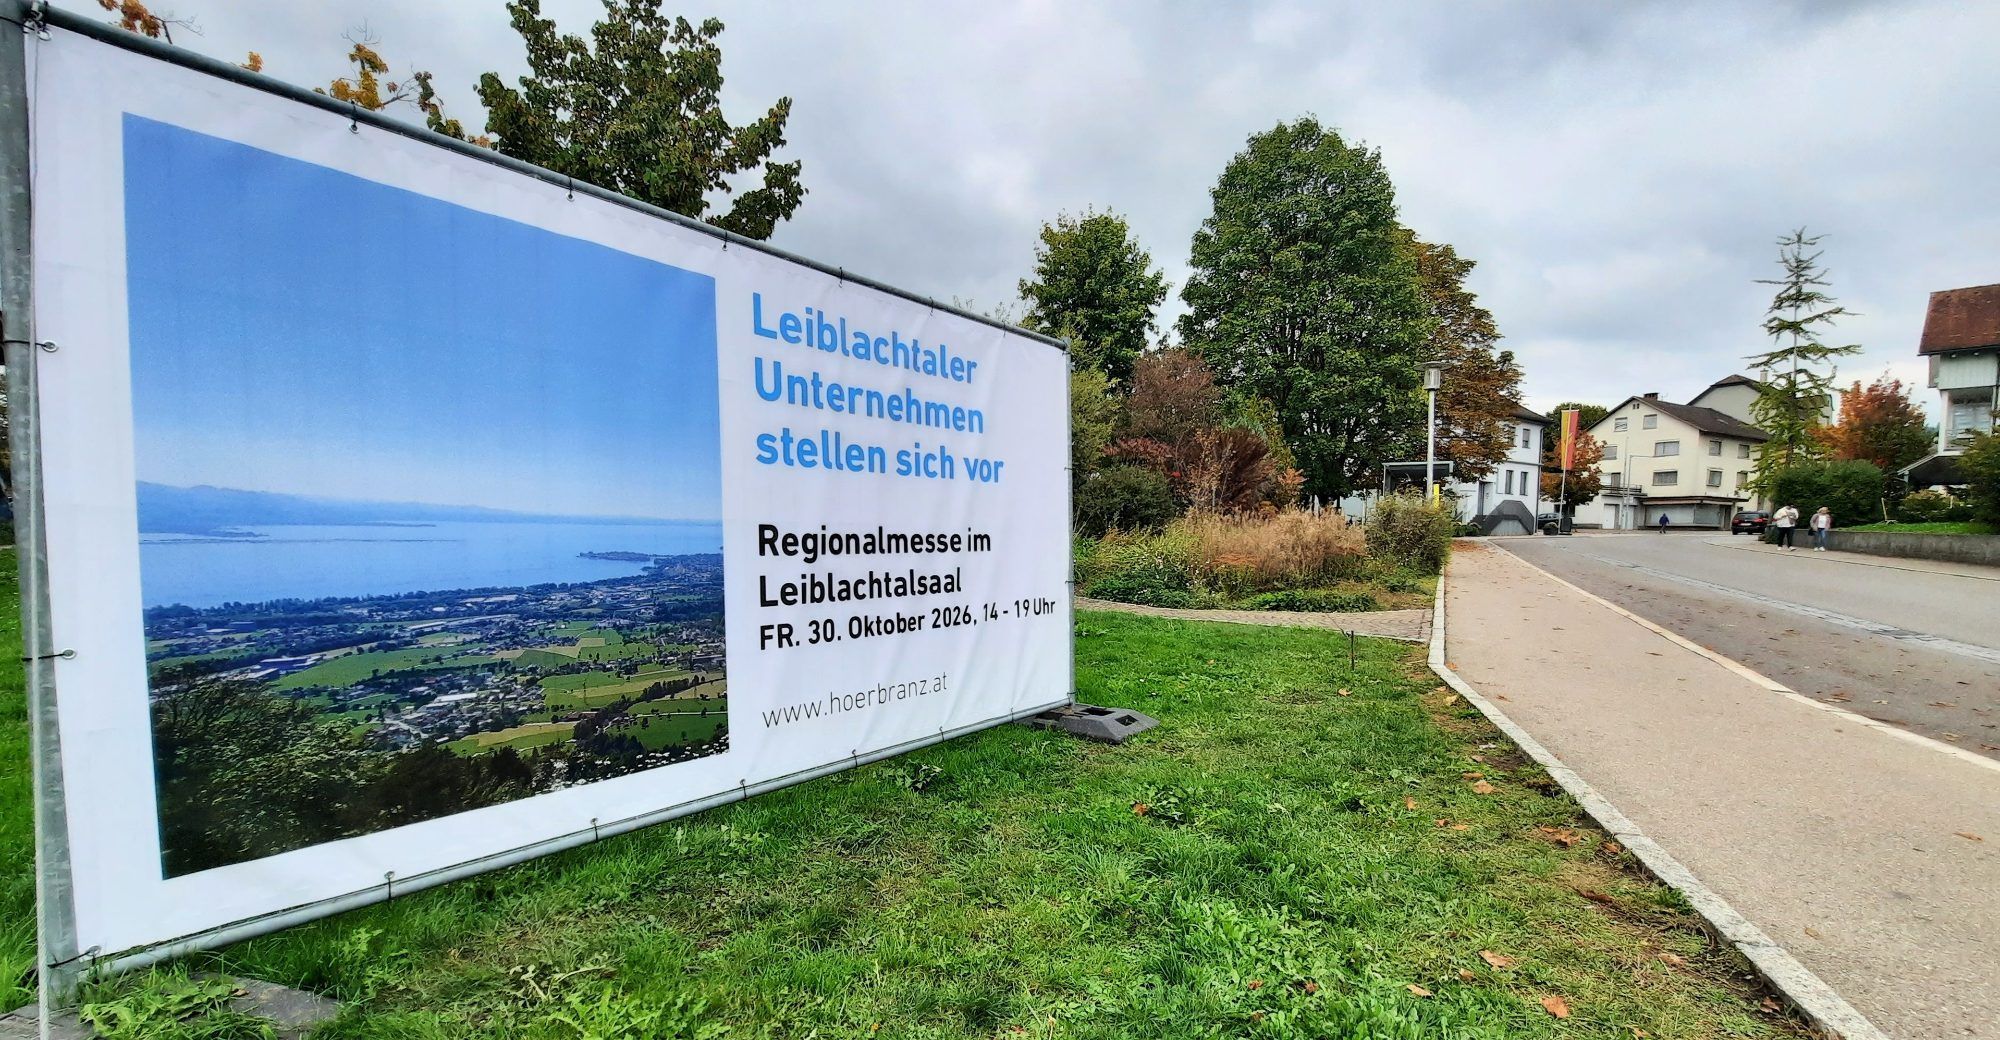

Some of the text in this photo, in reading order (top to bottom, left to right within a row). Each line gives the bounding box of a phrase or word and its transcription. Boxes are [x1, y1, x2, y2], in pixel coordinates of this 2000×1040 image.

[752, 292, 977, 384] Leiblachtaler
[754, 357, 984, 434] Unternehmen
[755, 428, 1004, 483] stellen sich vor
[758, 524, 992, 563] Regionalmesse im
[759, 567, 962, 608] Leiblachtalsaal
[760, 623, 800, 650] FR.
[808, 618, 842, 644] 30.
[849, 612, 925, 639] Oktober
[983, 602, 998, 621] 14
[1015, 599, 1029, 618] 19
[1033, 597, 1056, 616] Uhr
[762, 671, 948, 728] www.hoerbranz.at
